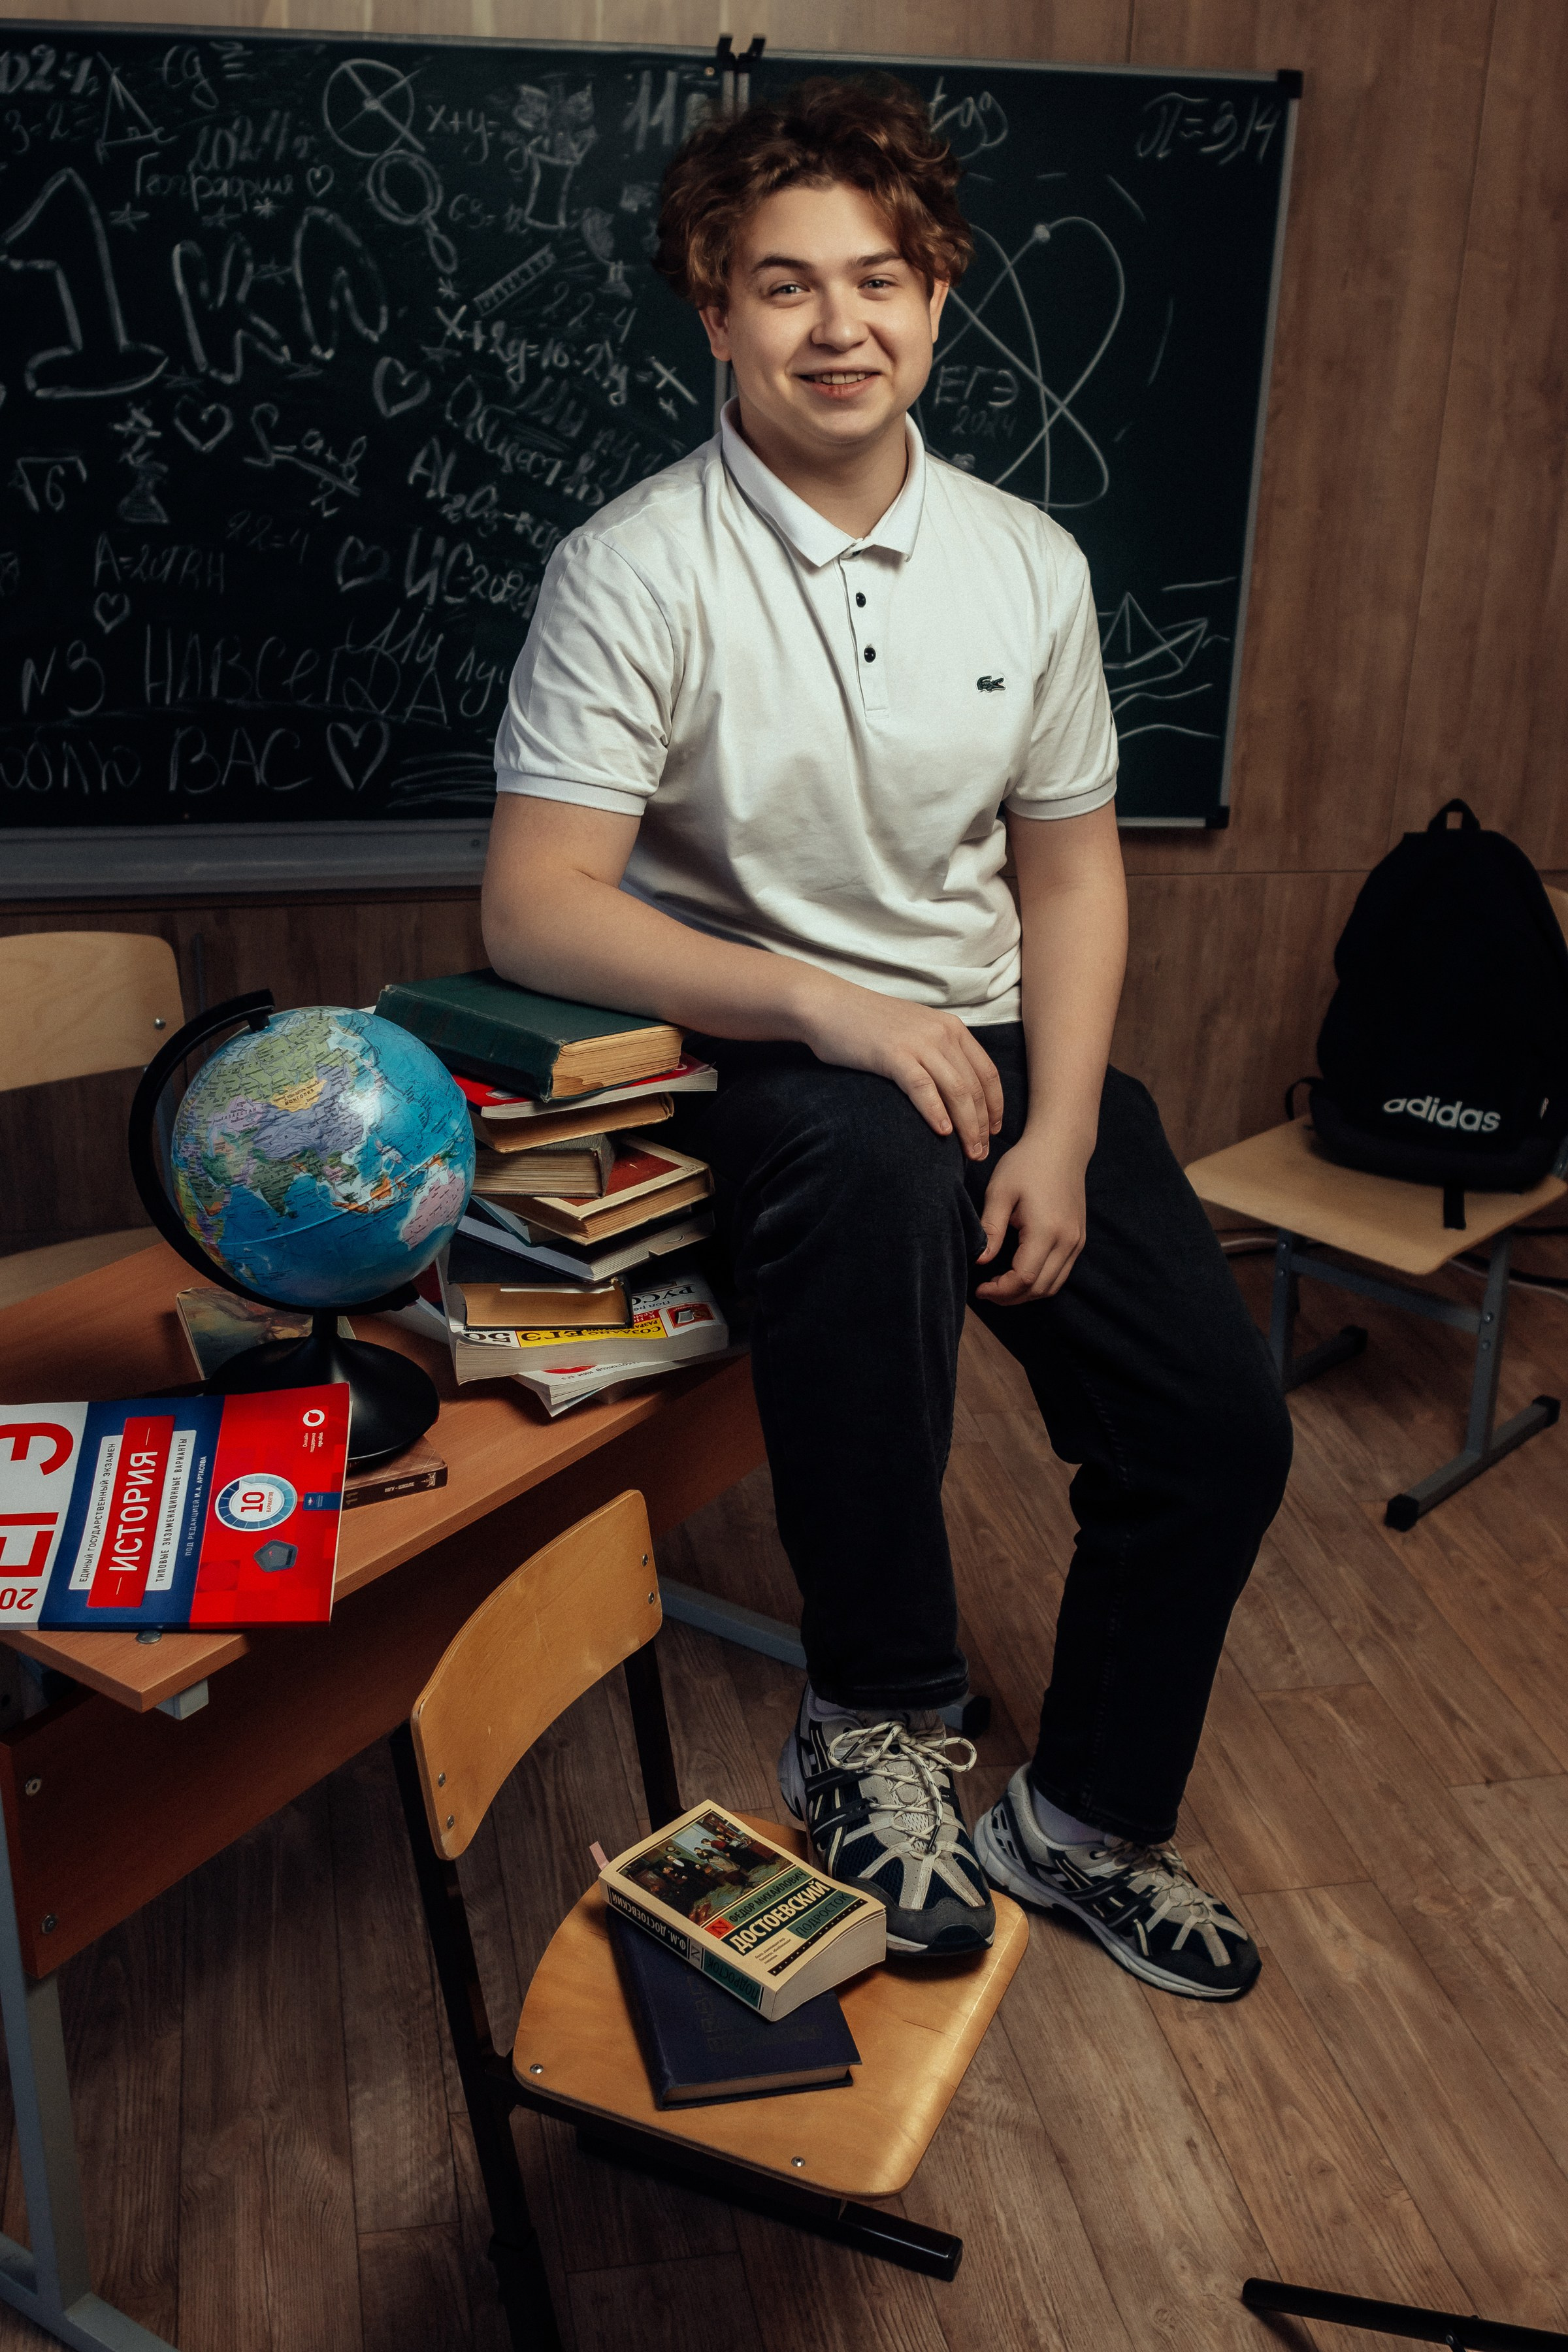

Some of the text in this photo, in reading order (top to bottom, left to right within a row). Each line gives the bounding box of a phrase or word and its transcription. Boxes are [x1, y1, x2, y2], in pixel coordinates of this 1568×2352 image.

[934, 366, 1019, 408] ЕГЭ
[169, 724, 313, 794] ВАС
[284, 1088, 314, 1105] МОНГОЛИЯ
[1382, 1095, 1501, 1132] adidas
[463, 1333, 512, 1343] 50
[521, 1330, 585, 1341] ЕГЭ
[197, 1456, 206, 1484] АРТАСОВА
[79, 1443, 116, 1582] ЕДИНЫЙ ГОСУДАРСТВЕННЫЙ ЭКЗАМЕН
[108, 1451, 158, 1571] ИСТОРИЯ
[155, 1438, 188, 1582] ТИПОВЫЕ ЭКЗАМЕНАЦИОННЫЕ ВАРИАНТЫ
[187, 1497, 200, 1540] РЕДАКЦИЕЙ
[240, 1492, 265, 1513] 10
[185, 1541, 194, 1556] ПОД
[612, 1892, 666, 1936] ДОСТОЕВСКИЙ
[728, 1870, 808, 1922] ФЕДОР МИХАЙЛОВИЧ
[729, 1880, 832, 1954] ДОСТОЕВСКИЙ
[795, 1892, 850, 1936] ПОДРОСТОК
[707, 1957, 760, 2000] ПОДРОСТОК
